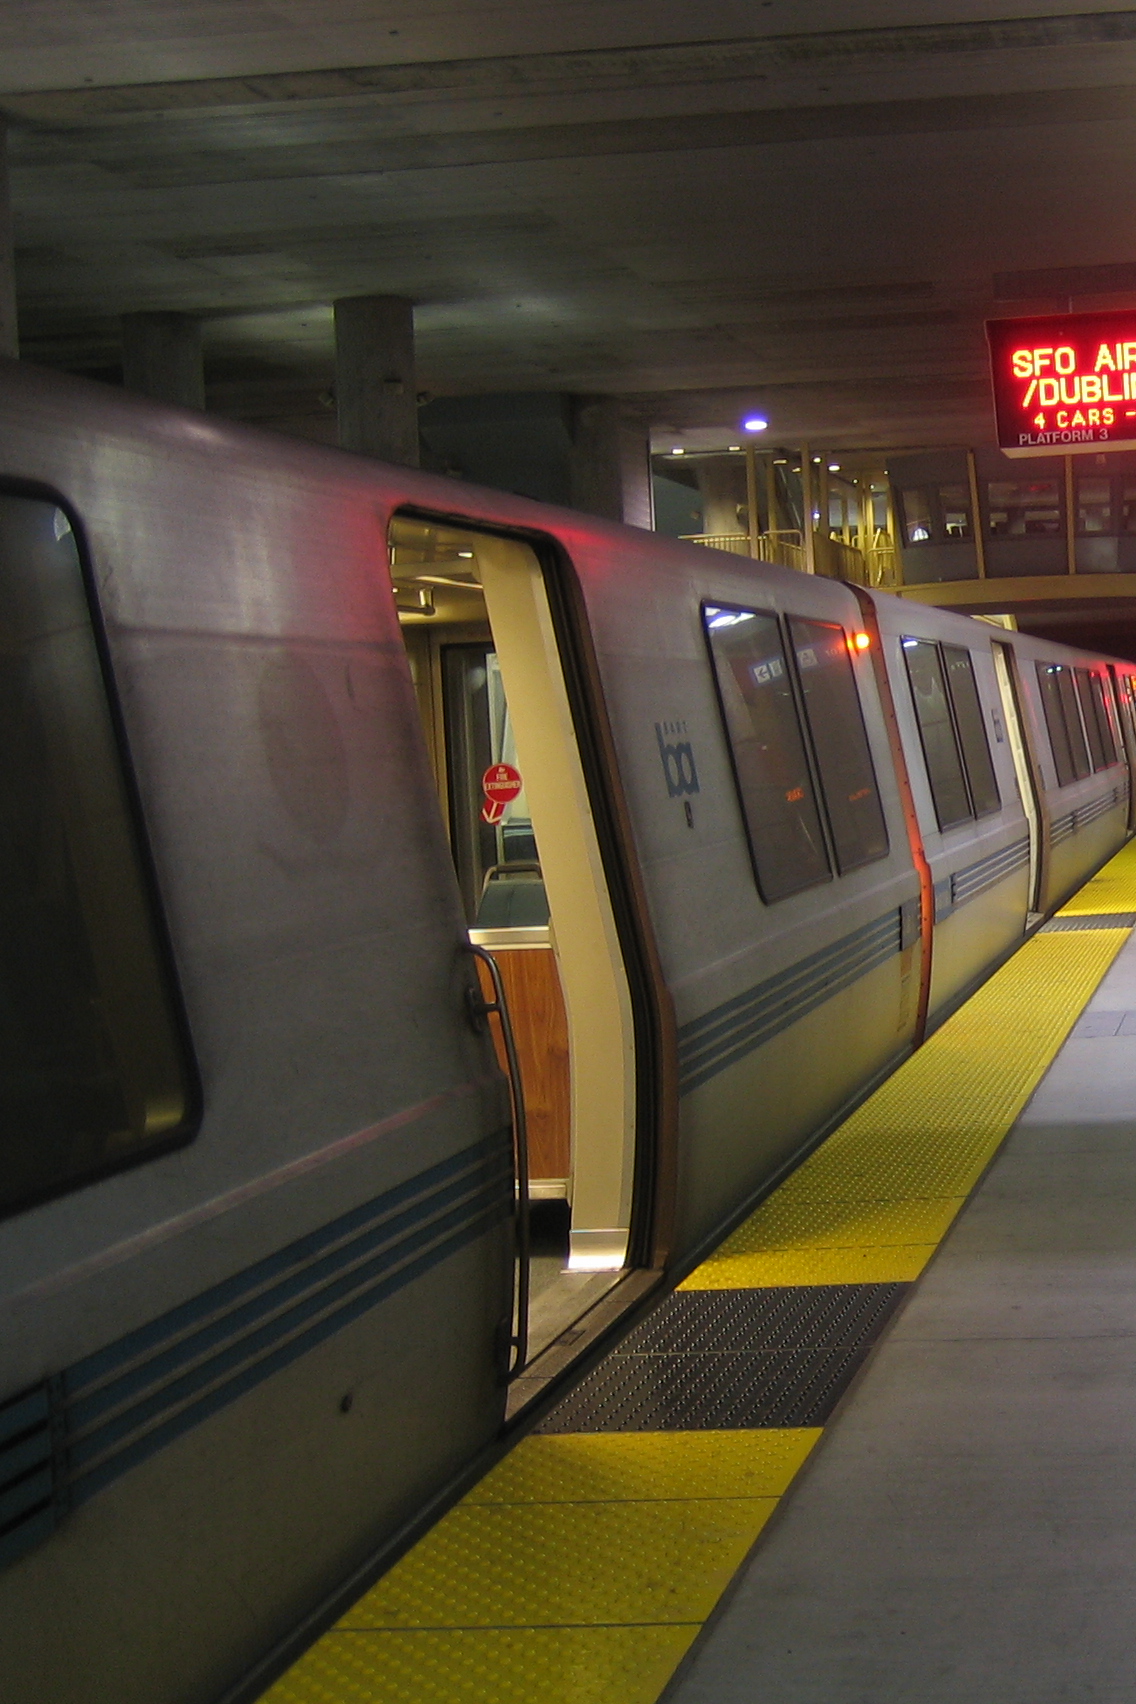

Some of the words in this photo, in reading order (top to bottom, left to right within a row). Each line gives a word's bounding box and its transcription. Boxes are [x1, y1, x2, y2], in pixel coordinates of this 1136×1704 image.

[1012, 346, 1076, 378] SFO
[1033, 412, 1045, 429] 4
[1056, 408, 1115, 428] CARS
[1018, 430, 1094, 445] PLATFORM
[1098, 429, 1109, 441] 3
